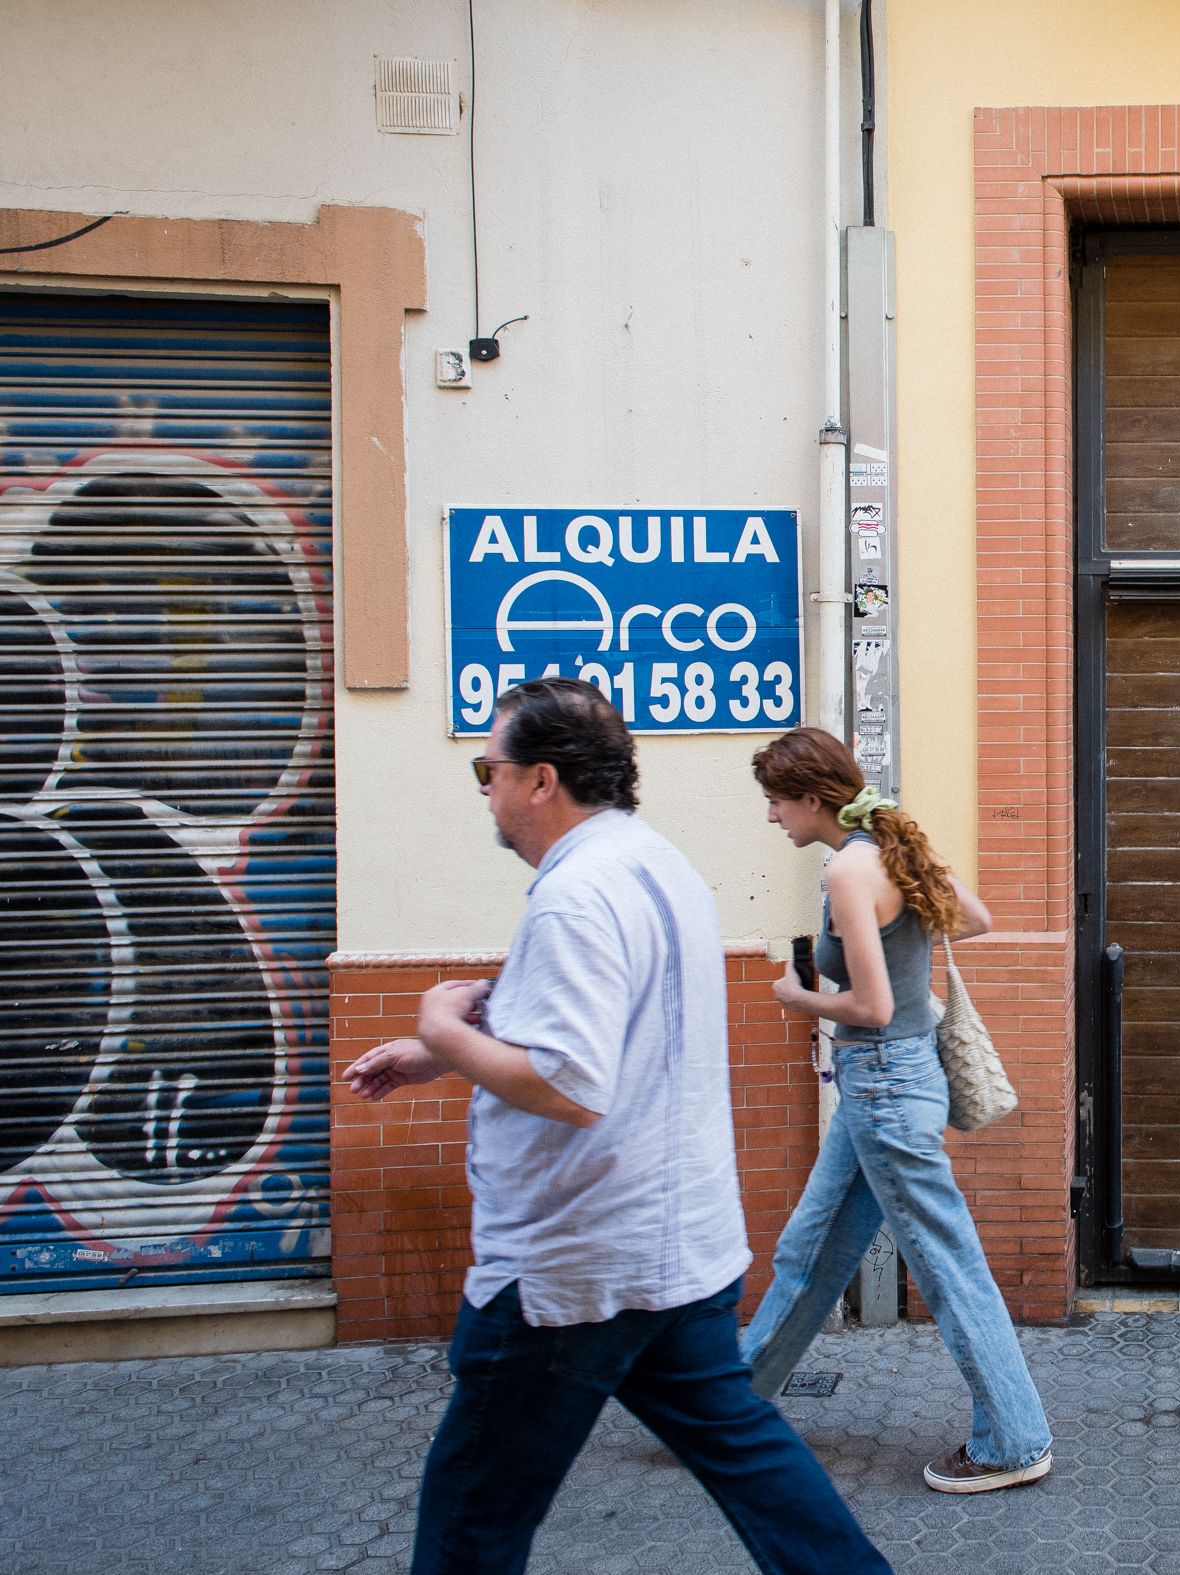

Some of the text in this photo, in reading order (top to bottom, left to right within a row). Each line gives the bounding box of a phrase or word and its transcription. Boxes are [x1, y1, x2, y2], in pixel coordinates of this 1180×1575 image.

[468, 515, 780, 567] ALQUILA
[496, 570, 757, 652] Arco
[648, 661, 717, 723] 58
[728, 661, 794, 723] 33
